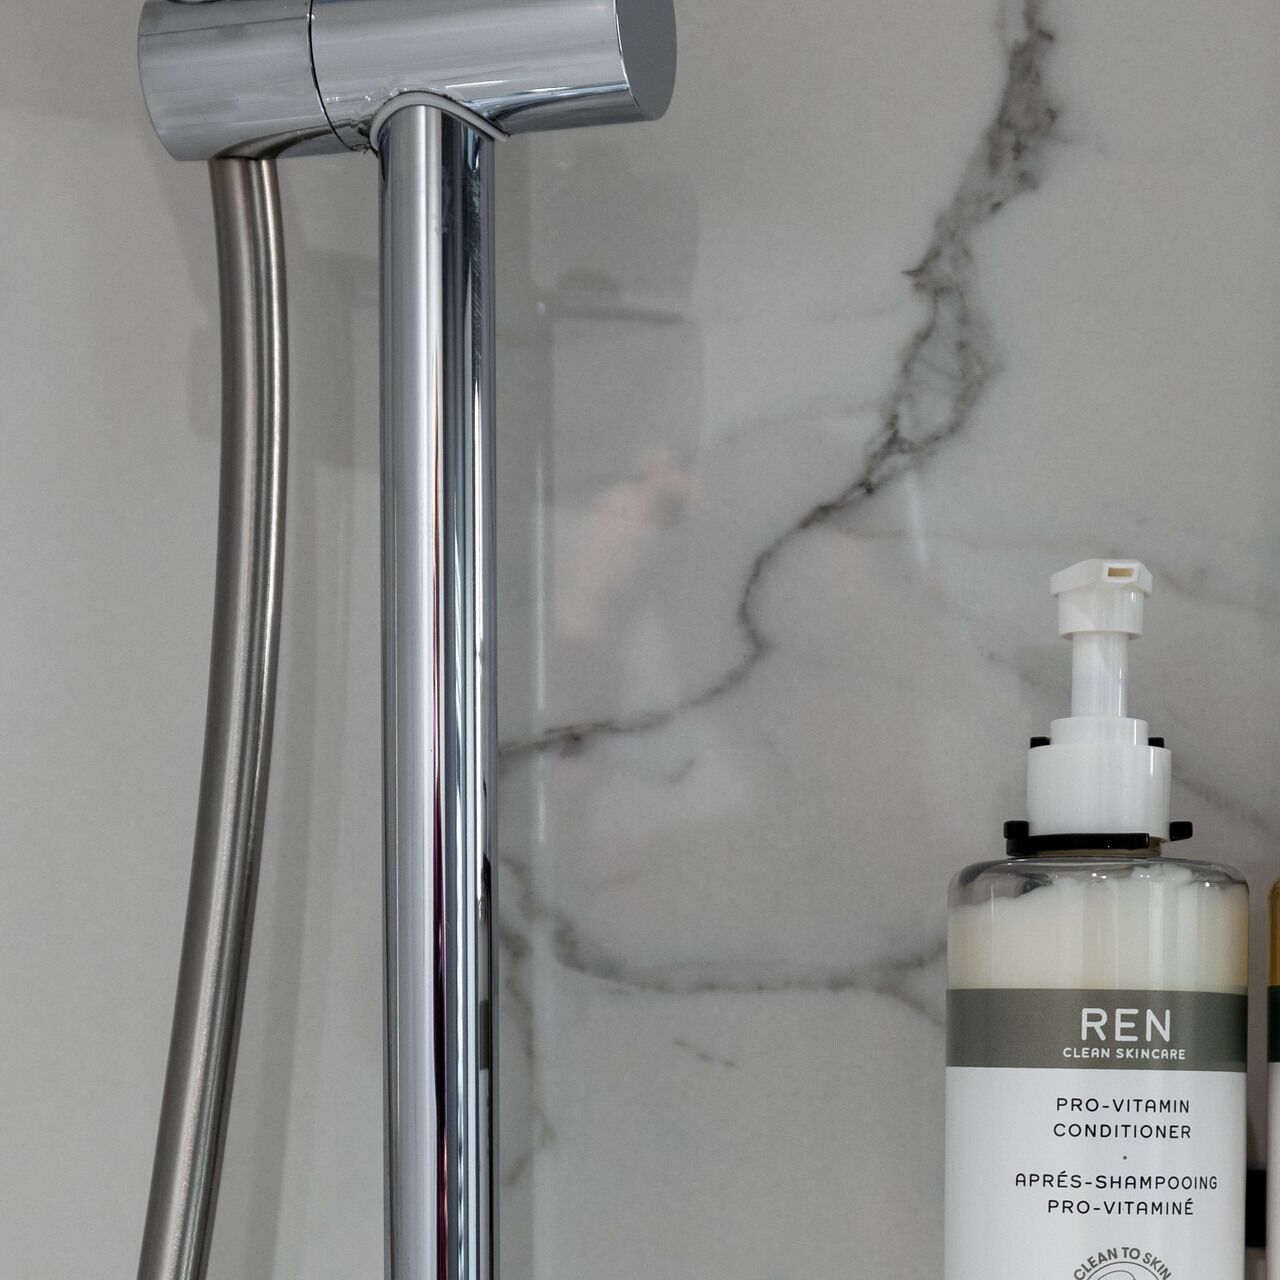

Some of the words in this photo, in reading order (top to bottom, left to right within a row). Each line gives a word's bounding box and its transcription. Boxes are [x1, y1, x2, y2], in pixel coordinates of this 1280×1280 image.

[1081, 1007, 1171, 1043] REN
[1062, 1047, 1110, 1059] CLEAN
[1115, 1047, 1186, 1060] SKINCARE
[1056, 1097, 1190, 1114] PRO-VITAMIN
[1053, 1122, 1191, 1139] CONDITIONER
[1015, 1170, 1218, 1190] APRÉS-SHAMPOOING
[1047, 1197, 1194, 1216] PRO-VITAMINÉ
[1122, 1247, 1141, 1260] TO
